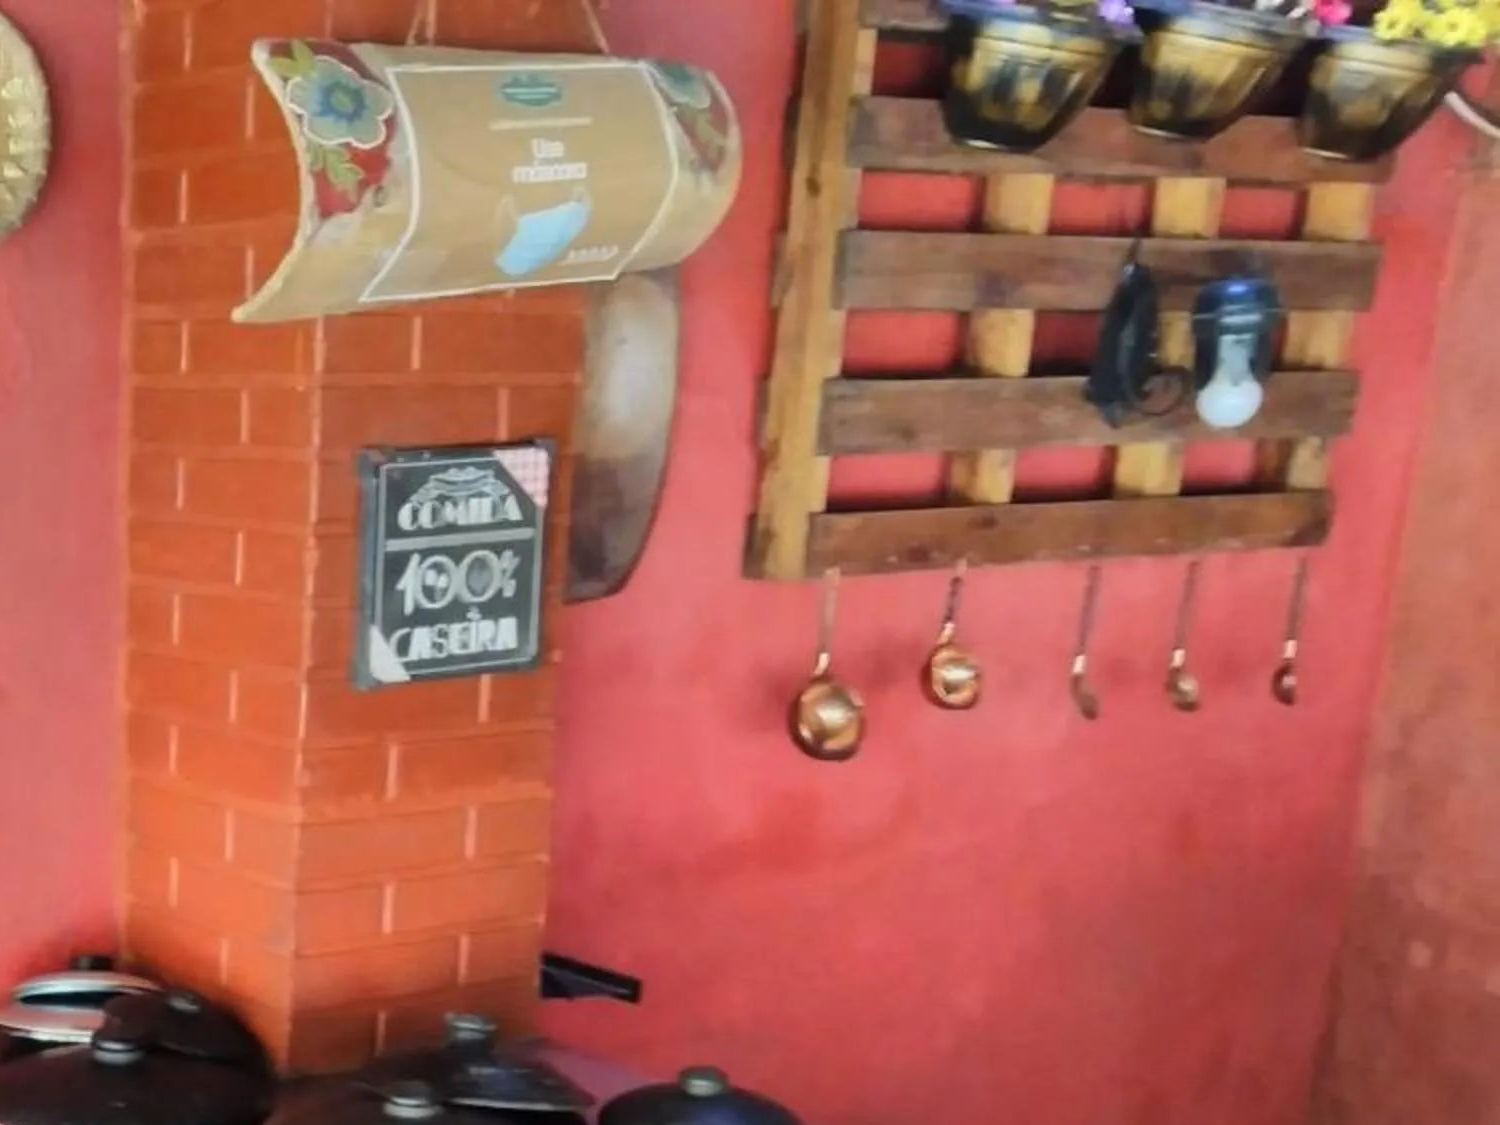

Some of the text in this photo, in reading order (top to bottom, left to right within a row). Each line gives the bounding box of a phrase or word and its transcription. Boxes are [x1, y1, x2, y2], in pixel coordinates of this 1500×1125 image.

[396, 494, 524, 531] COMIDA
[396, 549, 520, 616] 100%
[389, 616, 518, 663] CASEIRA
